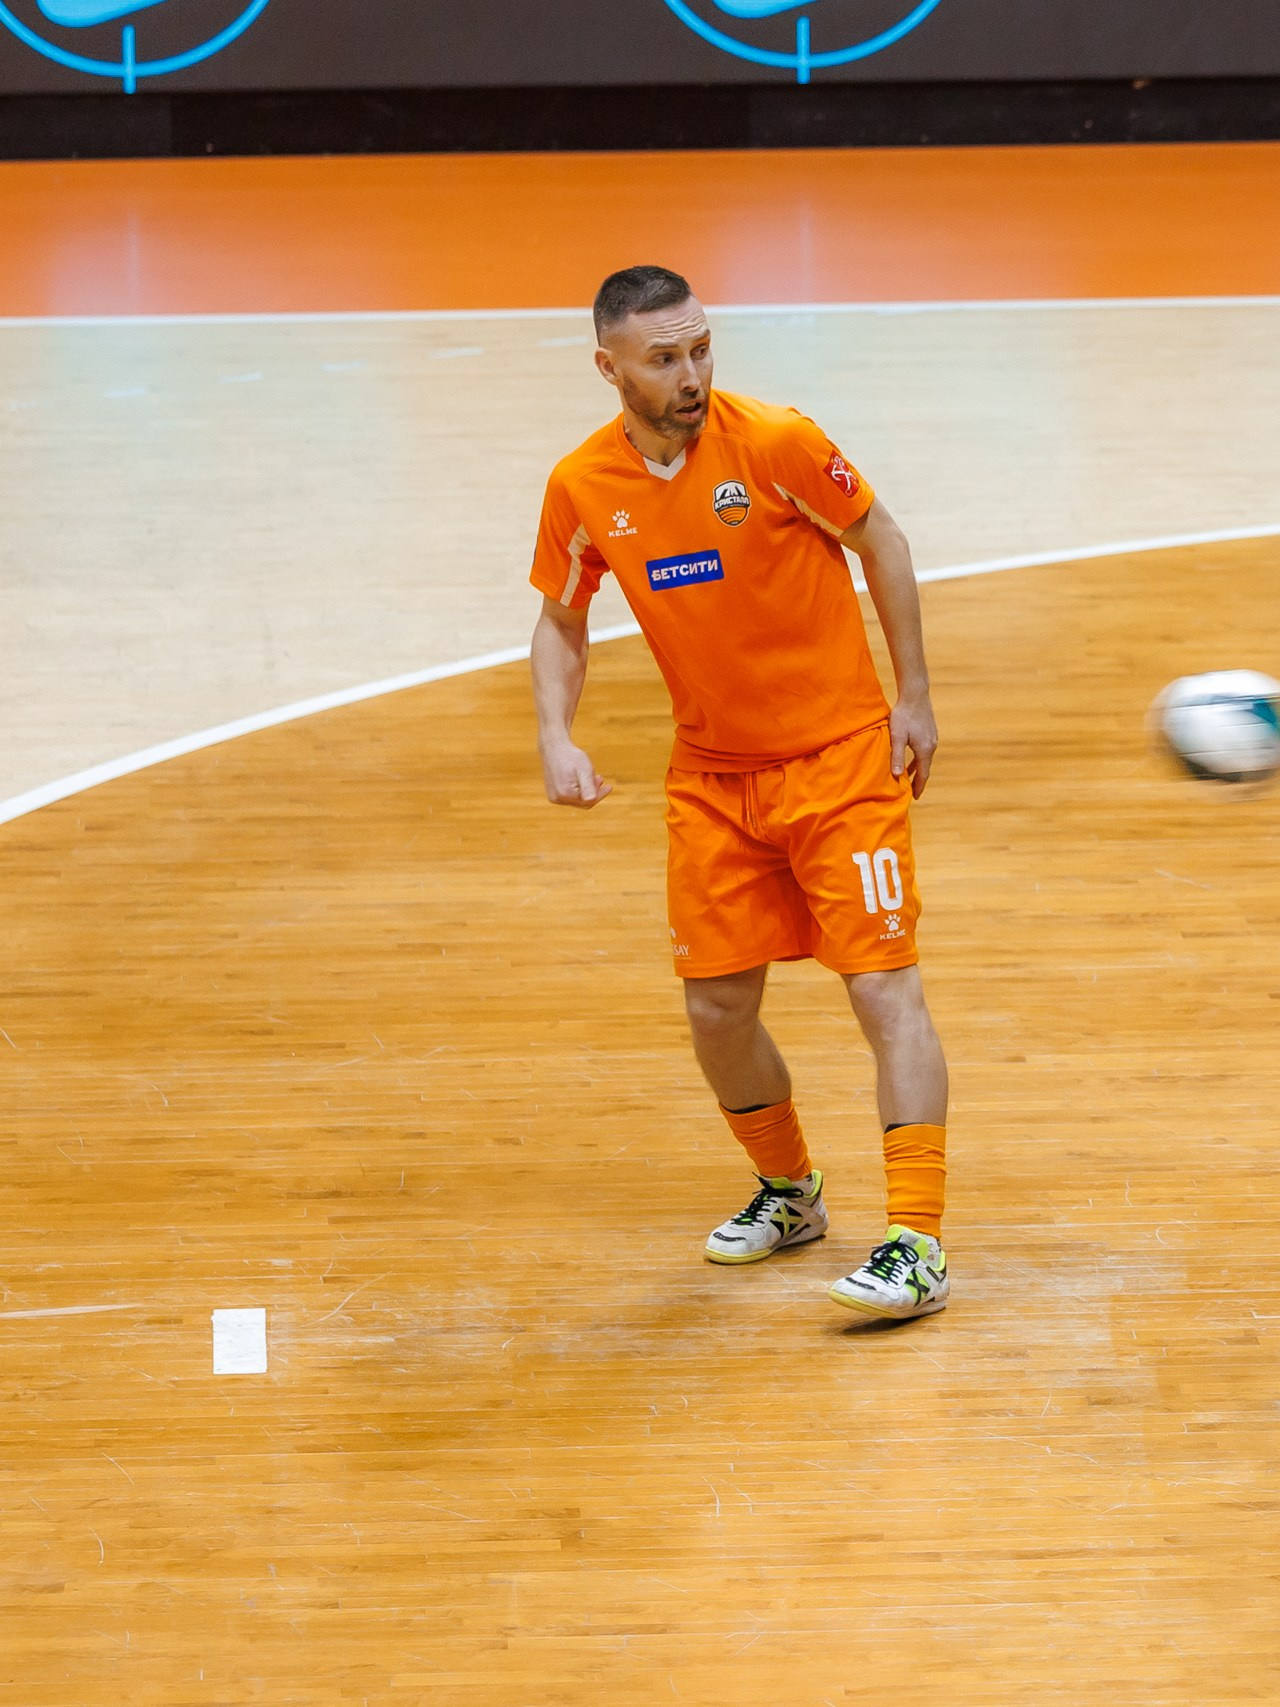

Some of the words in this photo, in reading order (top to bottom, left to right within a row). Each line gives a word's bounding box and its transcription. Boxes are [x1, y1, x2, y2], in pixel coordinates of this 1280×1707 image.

[608, 527, 638, 538] KELME
[651, 559, 719, 582] БЕТСИТИ
[852, 847, 904, 914] 10
[879, 929, 906, 941] KELME
